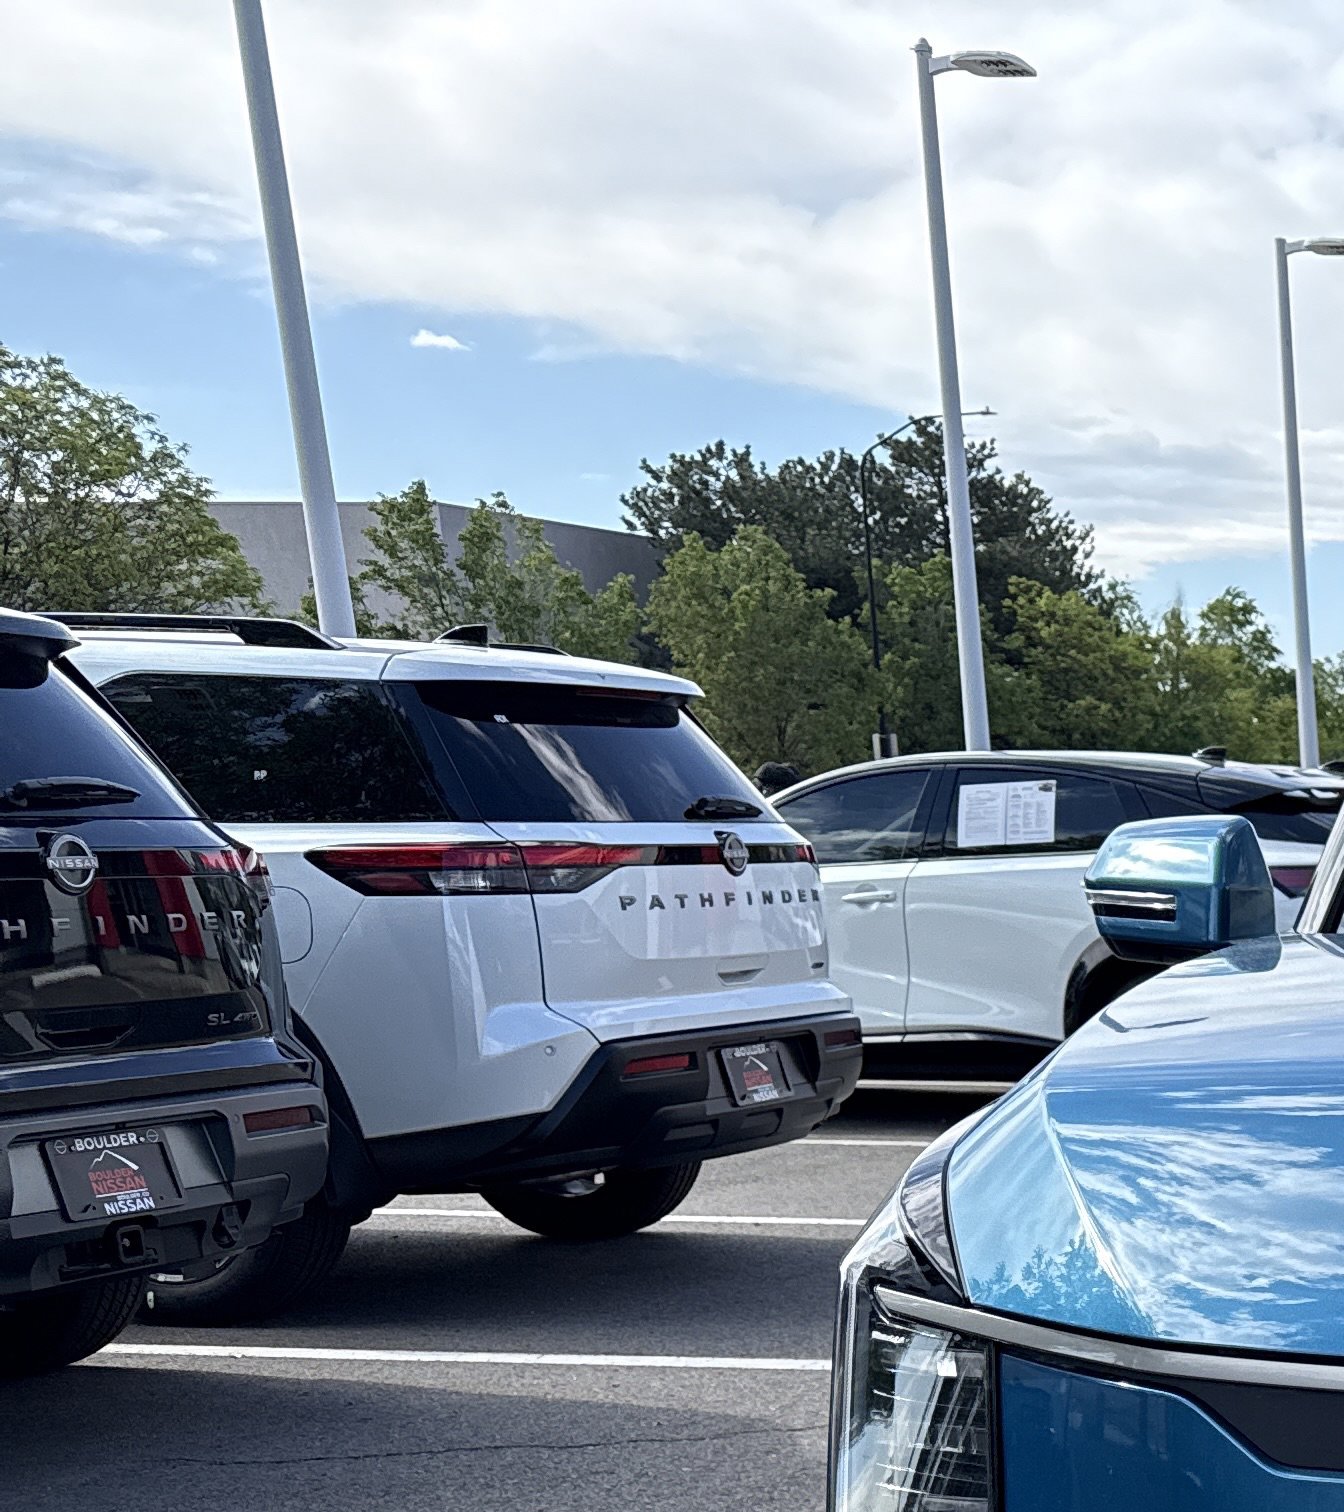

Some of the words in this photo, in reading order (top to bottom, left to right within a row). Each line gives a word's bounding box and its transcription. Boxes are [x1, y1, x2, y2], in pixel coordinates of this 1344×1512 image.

[48, 858, 97, 869] NISSAN
[0, 910, 248, 940] HFINDER
[207, 1012, 231, 1026] SL
[74, 1132, 139, 1151] BOULDER
[88, 1167, 135, 1182] BOULDER
[91, 1175, 147, 1195] NISSAN
[104, 1197, 156, 1215] NISSAN
